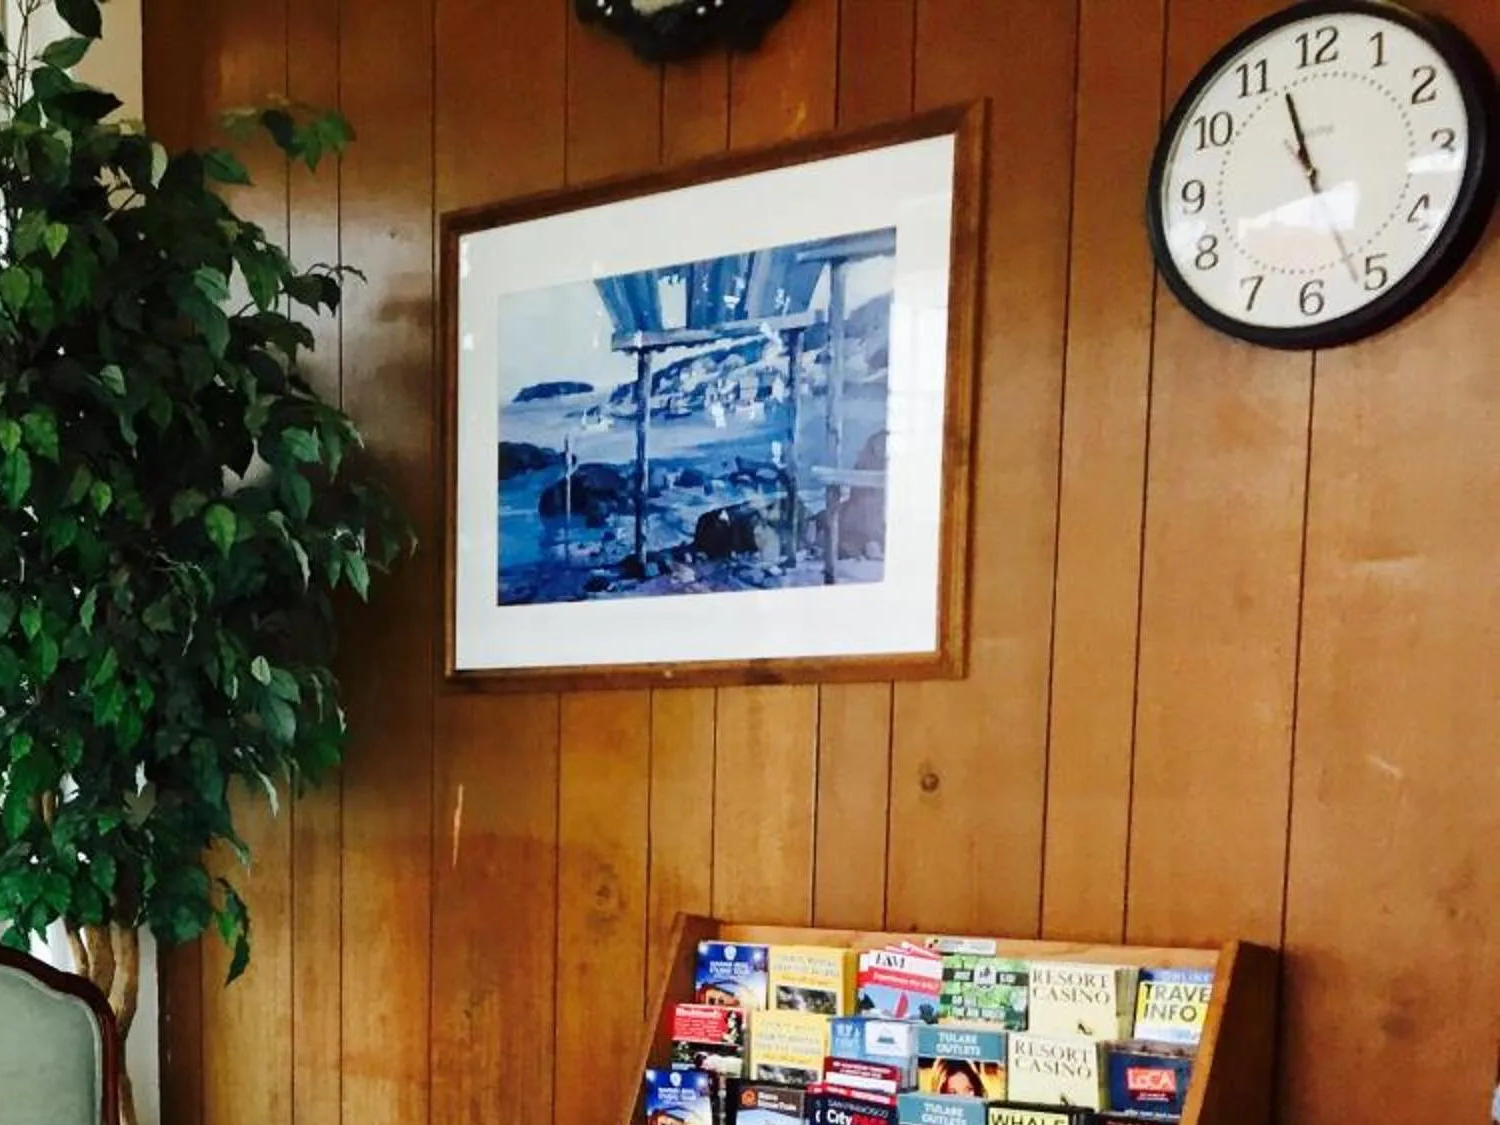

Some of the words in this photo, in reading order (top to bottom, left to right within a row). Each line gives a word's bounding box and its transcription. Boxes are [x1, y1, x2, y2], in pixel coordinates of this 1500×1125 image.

[1294, 26, 1340, 69] 12
[1368, 31, 1387, 68] 1
[1235, 58, 1271, 99] 11
[1411, 65, 1437, 104] 2
[1193, 111, 1234, 151] 10
[1431, 127, 1457, 156] 3
[1181, 179, 1206, 215] 9
[1407, 194, 1436, 231] 4
[1194, 235, 1219, 270] 8
[1364, 253, 1388, 291] 5
[1240, 275, 1264, 312] 7
[1299, 279, 1325, 316] 6
[1033, 969, 1109, 990] RESORT
[1033, 986, 1111, 1007] CASINO
[1143, 983, 1209, 1004] TRAVE
[1143, 1002, 1197, 1022] INFO
[1014, 1039, 1092, 1062] RESORT
[1014, 1057, 1092, 1081] CASINO
